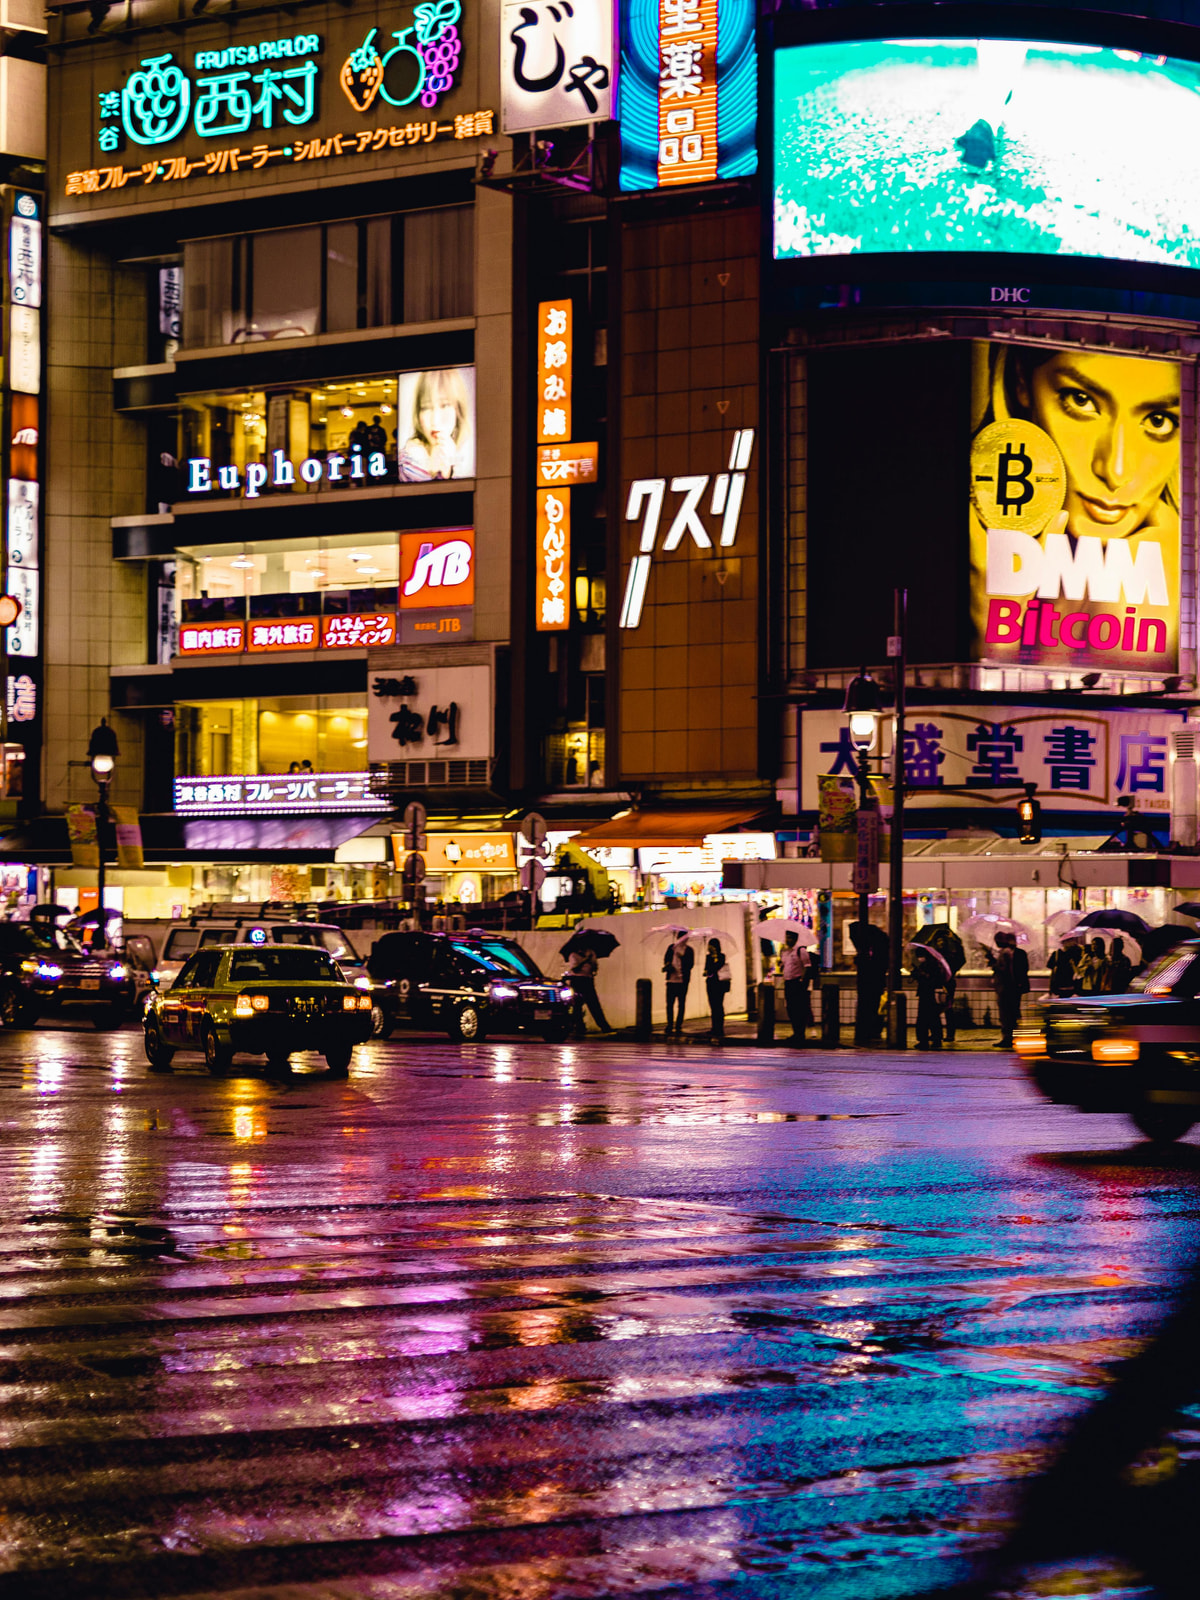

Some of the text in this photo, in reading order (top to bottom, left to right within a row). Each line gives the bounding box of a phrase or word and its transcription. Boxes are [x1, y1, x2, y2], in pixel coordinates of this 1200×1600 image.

[195, 35, 319, 70] FRUITS&PARLOR
[510, 1, 609, 114] じゃ
[99, 91, 121, 151] 渋谷
[194, 61, 318, 137] 西村
[990, 286, 1030, 303] DHC
[188, 444, 388, 498] Euphoria
[404, 540, 471, 596] JTB
[986, 528, 1169, 606] DMM
[330, 616, 389, 632] ハネムーン
[437, 618, 461, 633] JTB
[984, 599, 1168, 653] Bitcoin
[819, 723, 1168, 794] 大盛堂書店
